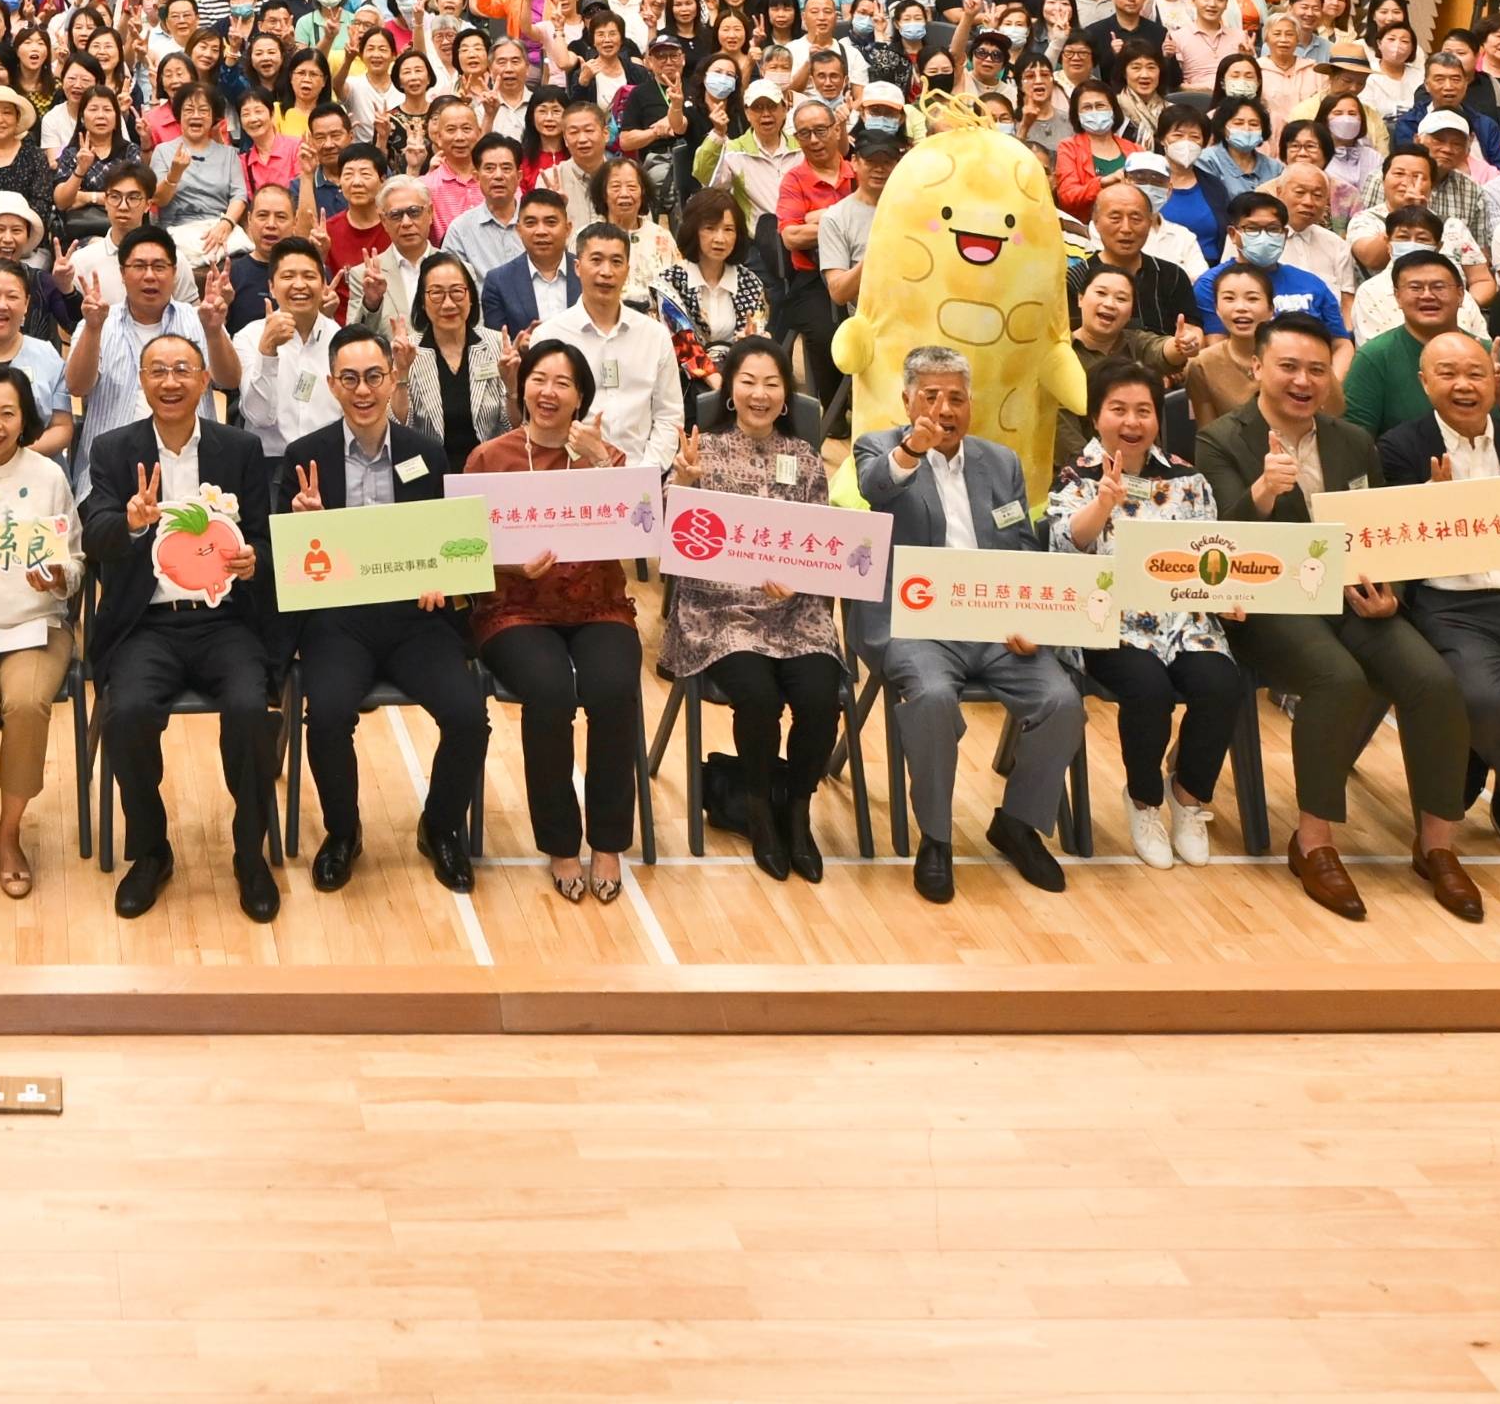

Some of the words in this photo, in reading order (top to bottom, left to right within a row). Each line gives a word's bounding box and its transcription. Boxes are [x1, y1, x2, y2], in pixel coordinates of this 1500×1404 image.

[489, 502, 629, 524] 香港廣西社團總會
[729, 524, 844, 556] 善德基金會
[1190, 534, 1237, 552] Gelaterie
[360, 558, 438, 575] 沙田民政事務處
[728, 549, 755, 560] SHINE
[759, 552, 775, 562] TAK
[778, 555, 842, 571] FOUNDATION
[1149, 559, 1196, 573] Stecco
[1230, 560, 1281, 575] Natura
[952, 583, 1077, 602] 旭日慈善基金
[1170, 588, 1209, 602] Gelato
[1234, 593, 1255, 601] stick
[951, 599, 963, 608] GS
[967, 600, 1009, 610] CHARITY
[1015, 602, 1076, 612] FOUNDATION
